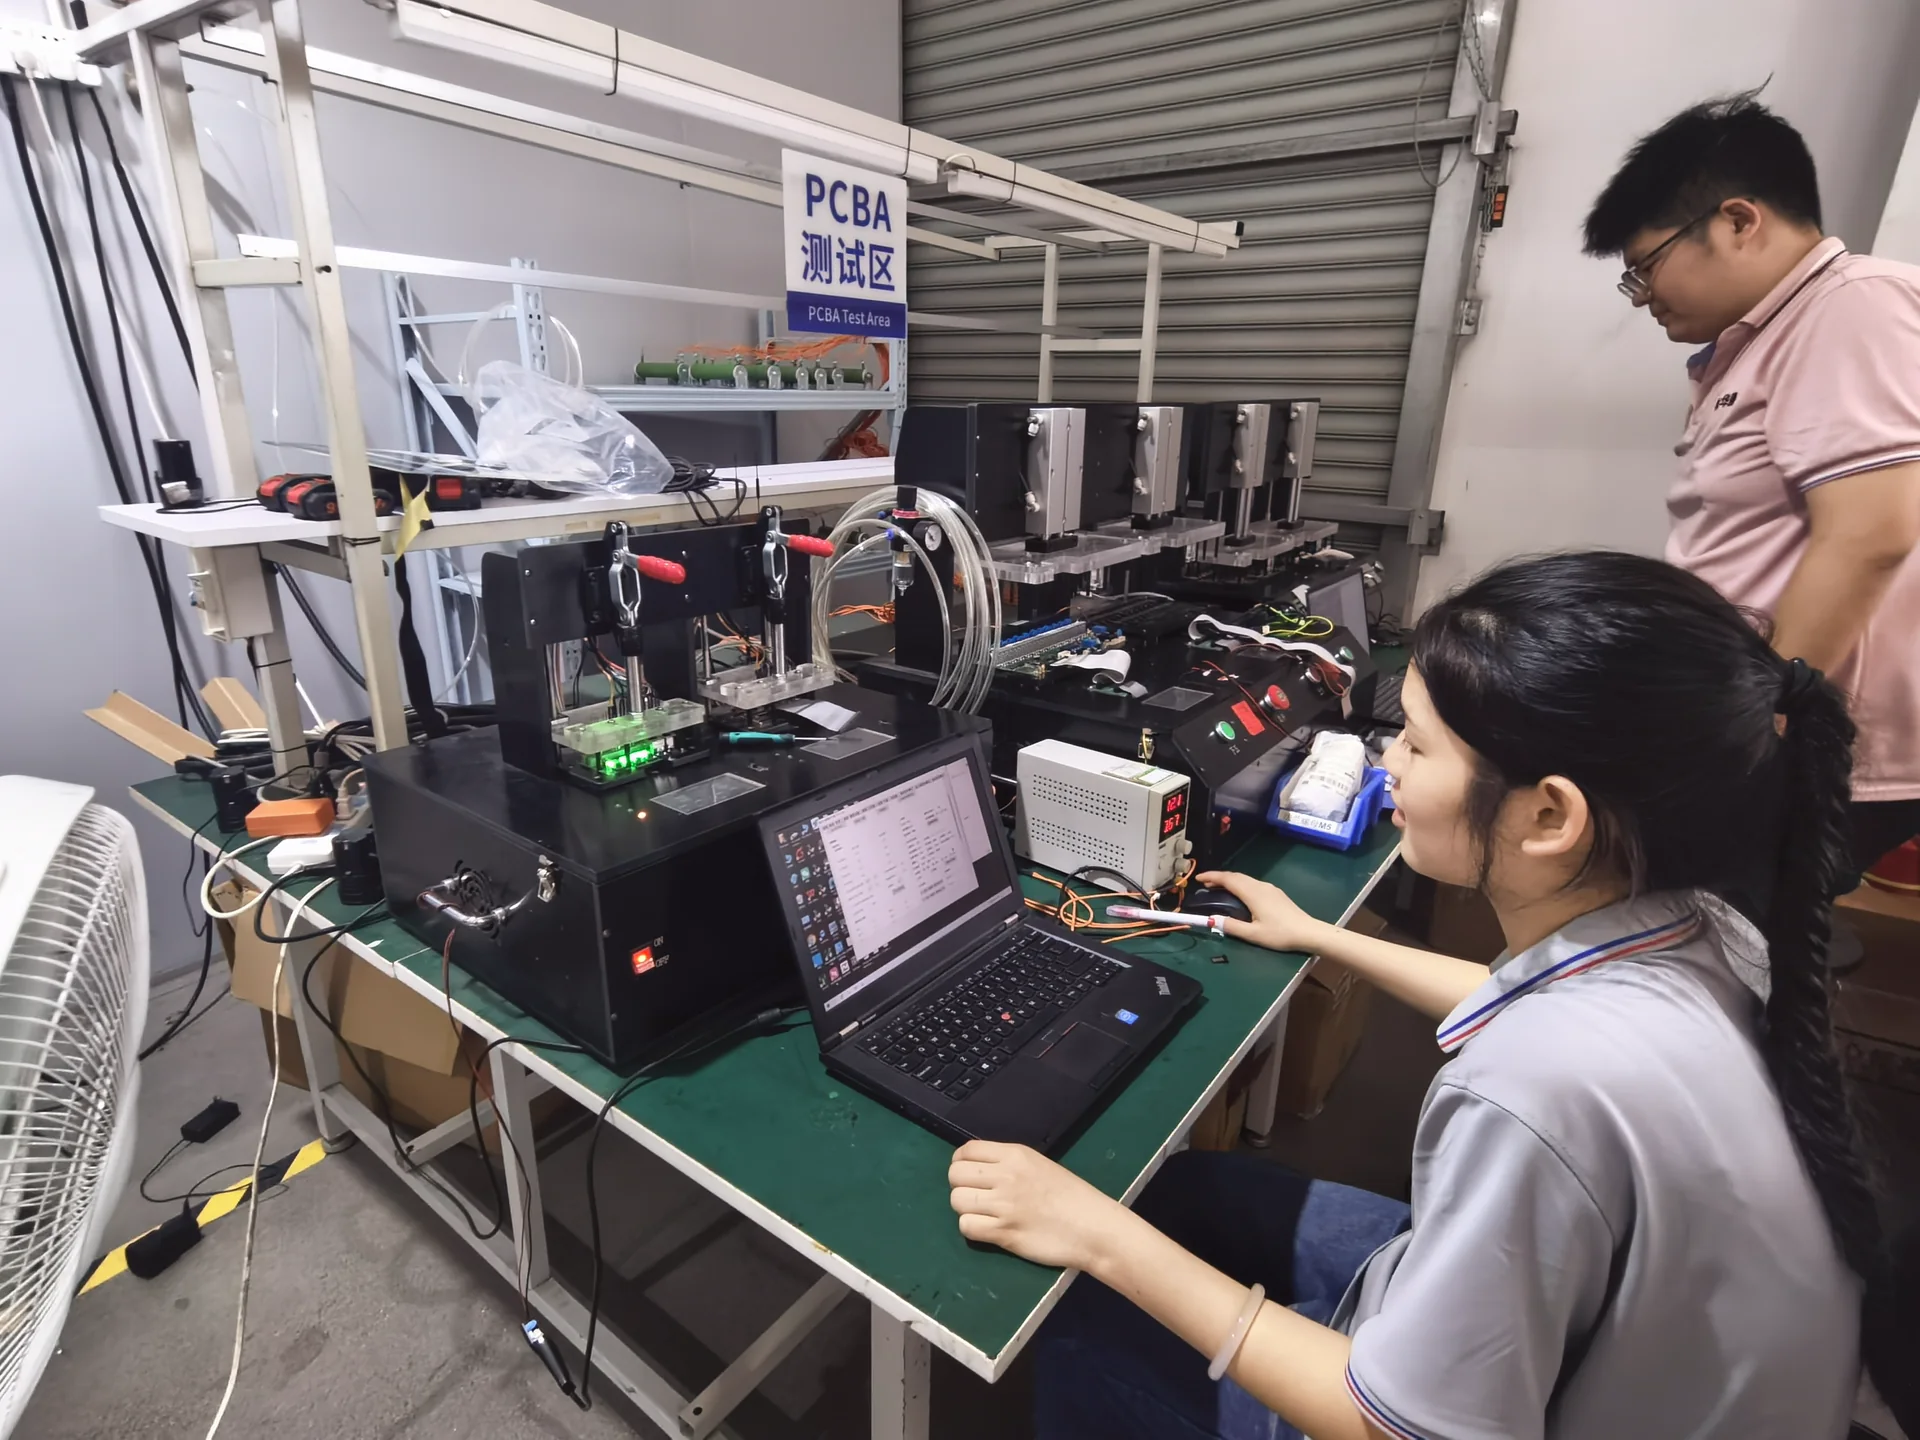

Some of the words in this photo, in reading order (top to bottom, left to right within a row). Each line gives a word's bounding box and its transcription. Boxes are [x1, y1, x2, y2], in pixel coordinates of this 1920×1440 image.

[806, 173, 892, 232] PCBA
[801, 230, 895, 291] 测试区
[808, 305, 841, 323] PCBA
[841, 309, 866, 325] Test
[867, 311, 891, 327] Area
